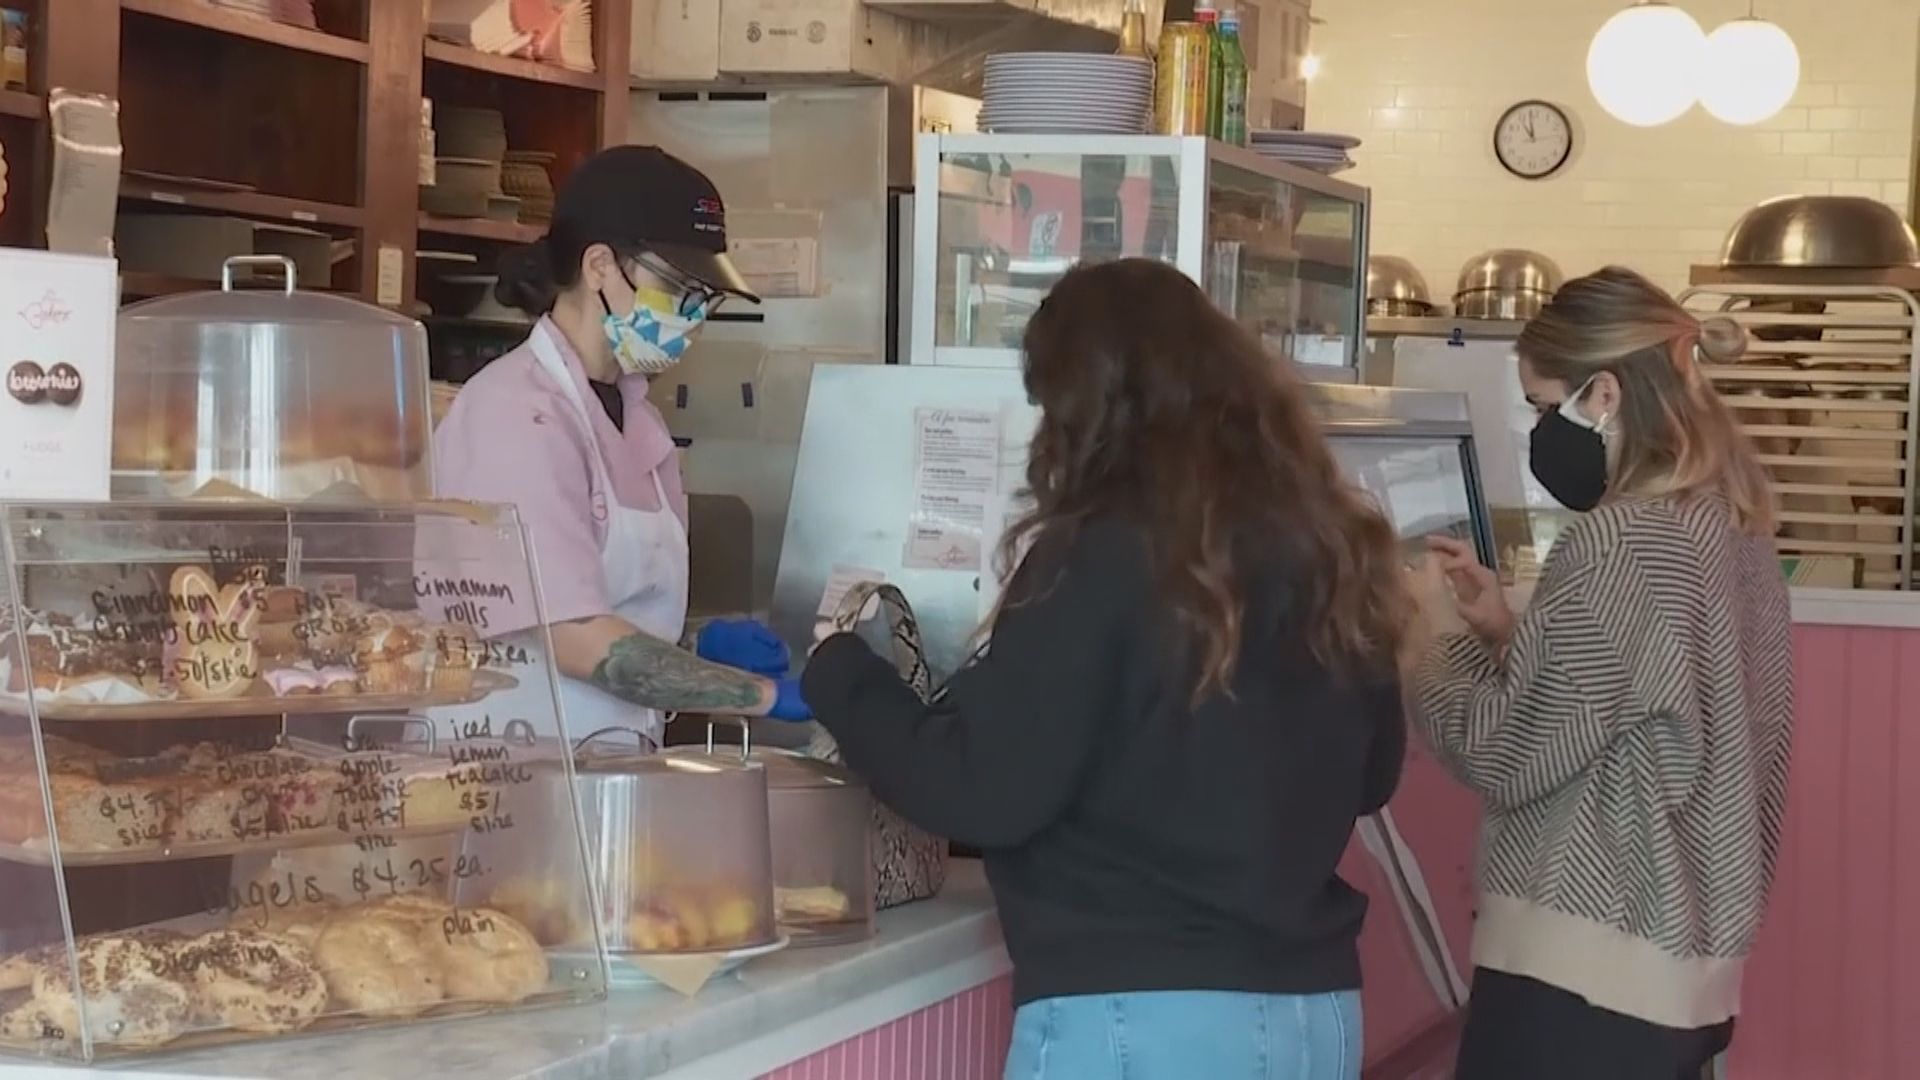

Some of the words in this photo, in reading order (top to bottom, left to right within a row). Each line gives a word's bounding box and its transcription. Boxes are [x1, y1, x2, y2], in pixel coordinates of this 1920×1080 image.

[443, 600, 489, 629] rolls
[450, 715, 493, 741] iced
[338, 753, 402, 786] apple
[350, 856, 444, 899] $4.25
[441, 908, 497, 945] plain
